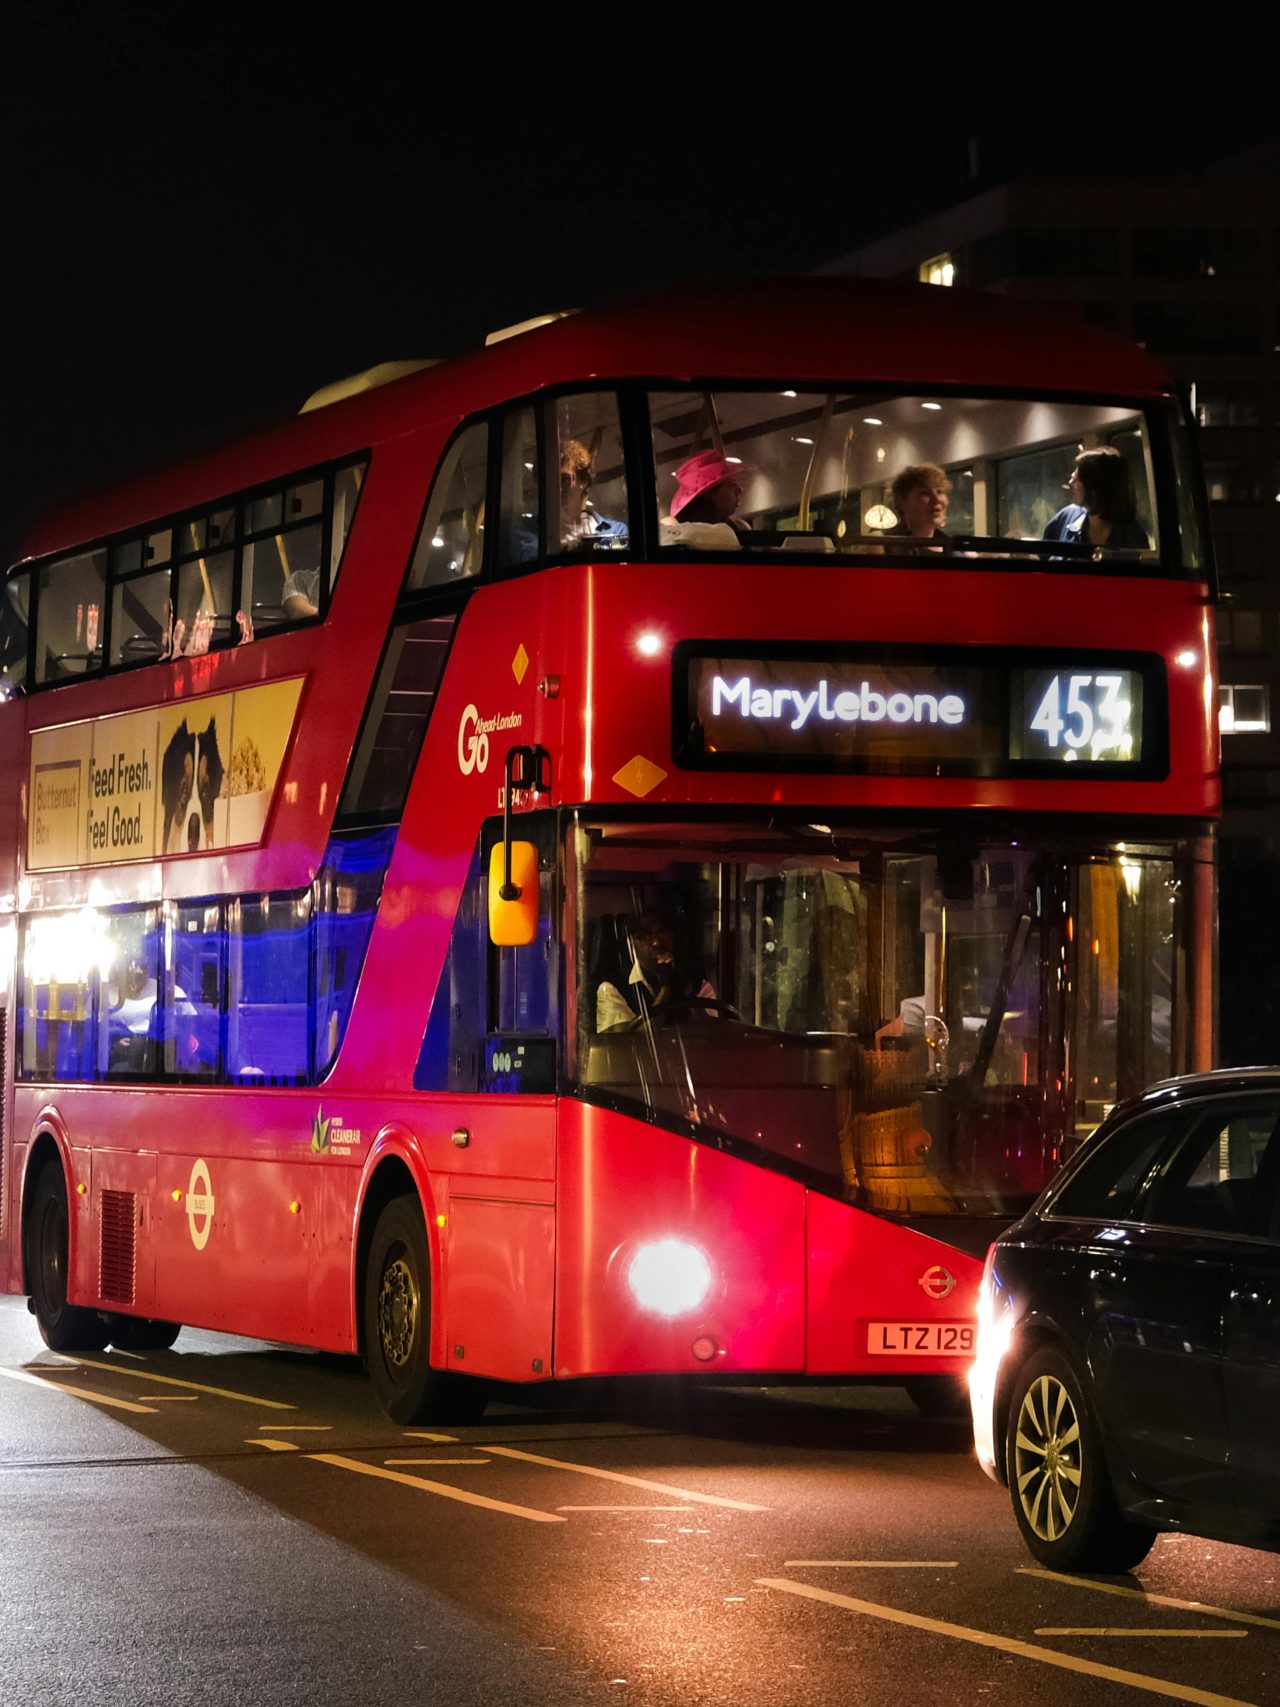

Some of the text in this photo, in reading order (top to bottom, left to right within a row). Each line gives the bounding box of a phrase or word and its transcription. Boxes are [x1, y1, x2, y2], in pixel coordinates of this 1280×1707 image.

[712, 675, 964, 729] Marylebone
[1030, 675, 1126, 748] 453
[458, 704, 489, 776] Go
[118, 749, 152, 793] Fresh.
[112, 802, 143, 847] Good.
[882, 1327, 974, 1350] LTZ 129
